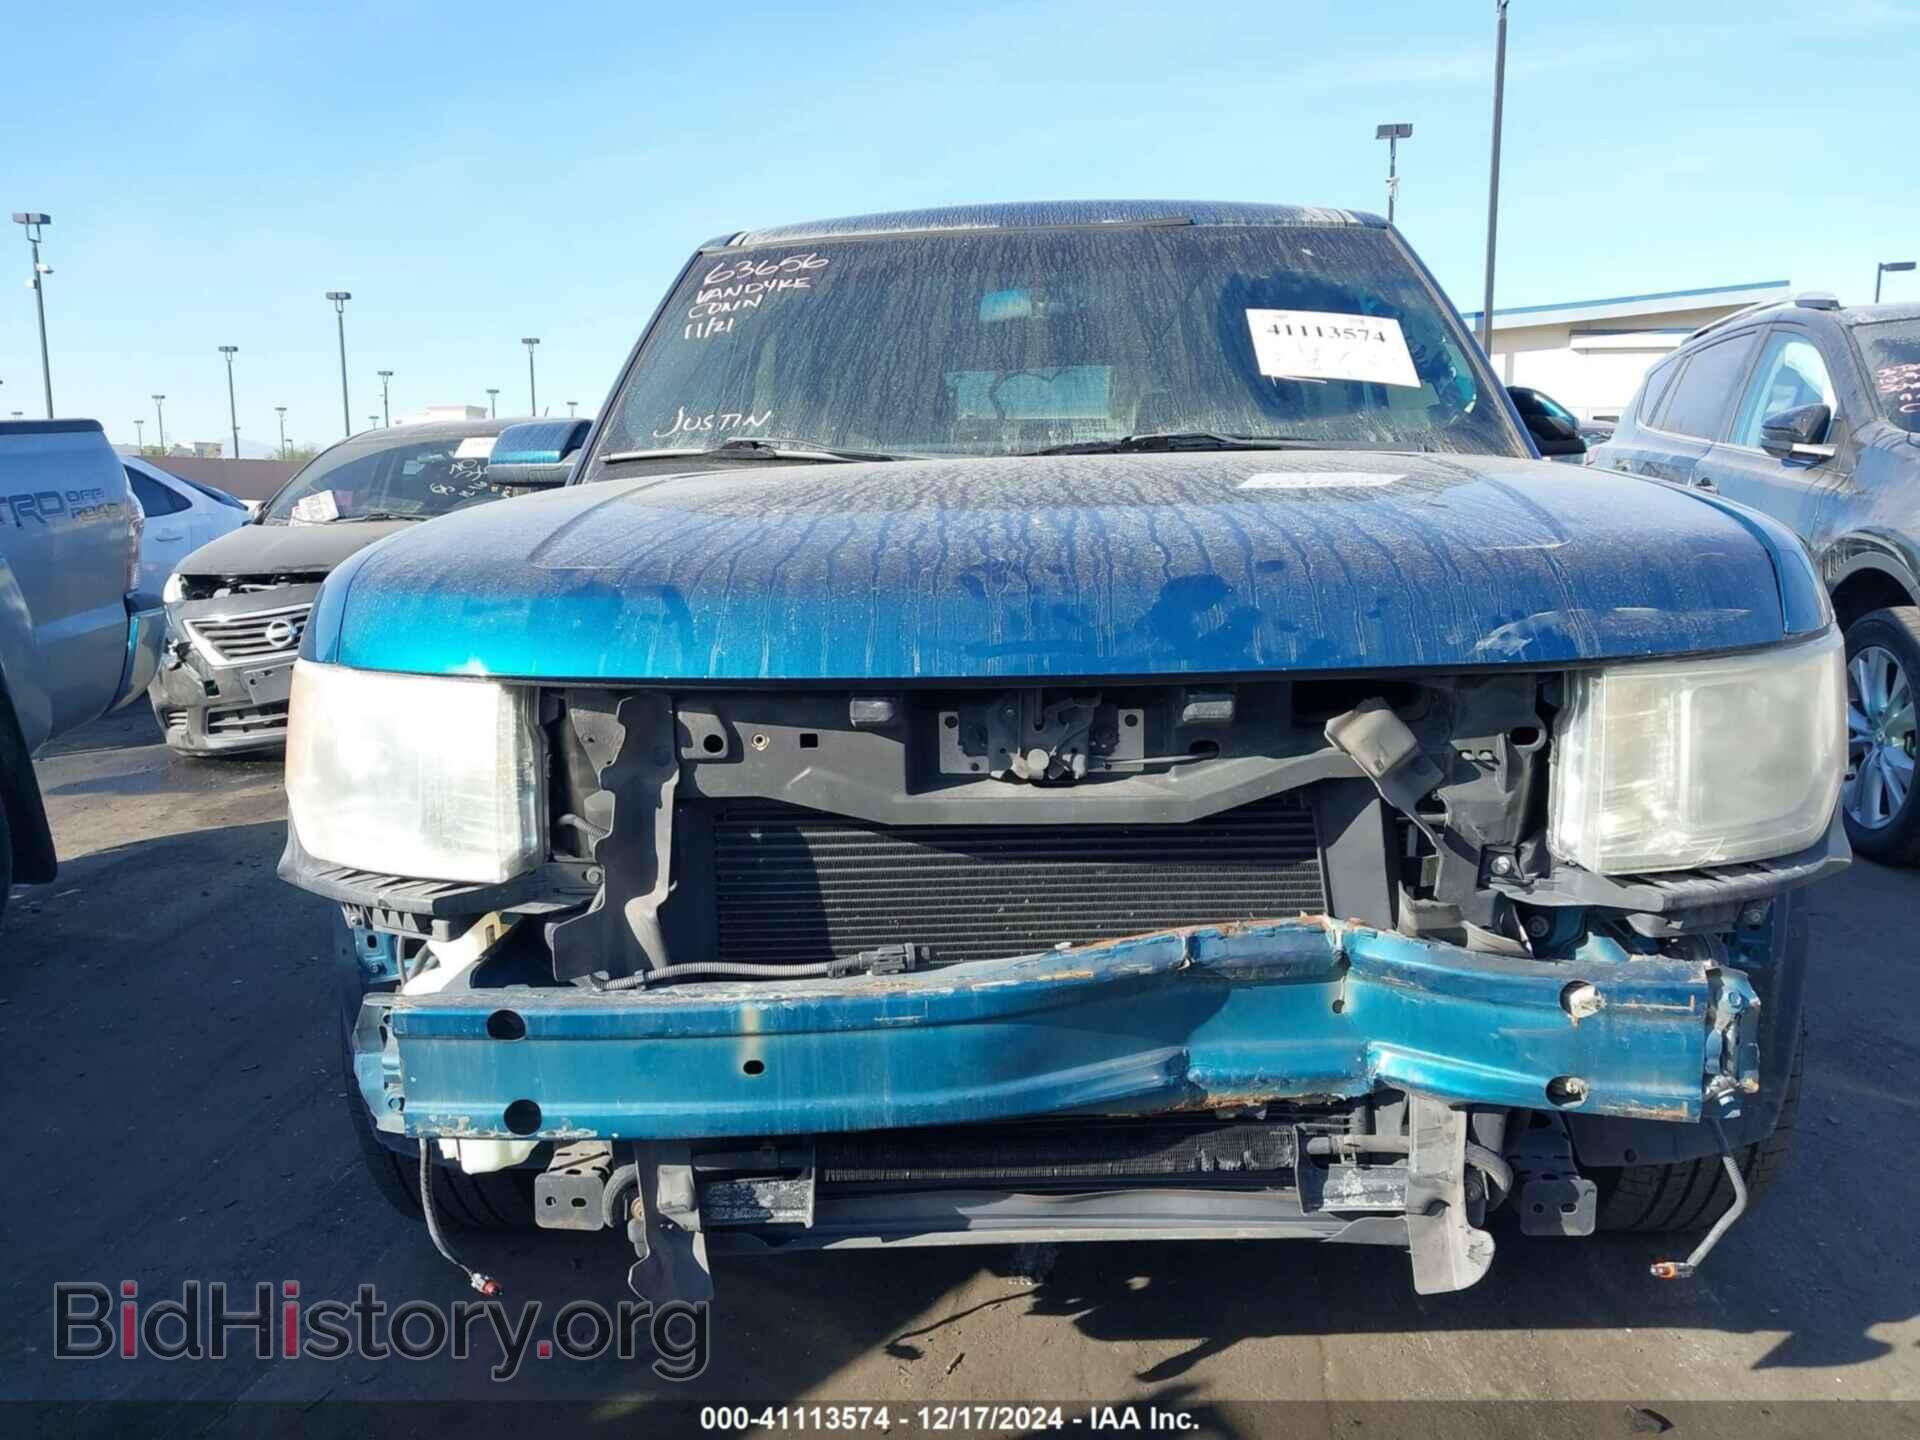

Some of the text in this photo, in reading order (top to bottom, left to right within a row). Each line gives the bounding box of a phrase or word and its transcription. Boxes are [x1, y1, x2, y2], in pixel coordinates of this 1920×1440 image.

[703, 252, 829, 286] 63656
[1266, 323, 1386, 343] 41113574
[652, 405, 772, 438] JUSTIN
